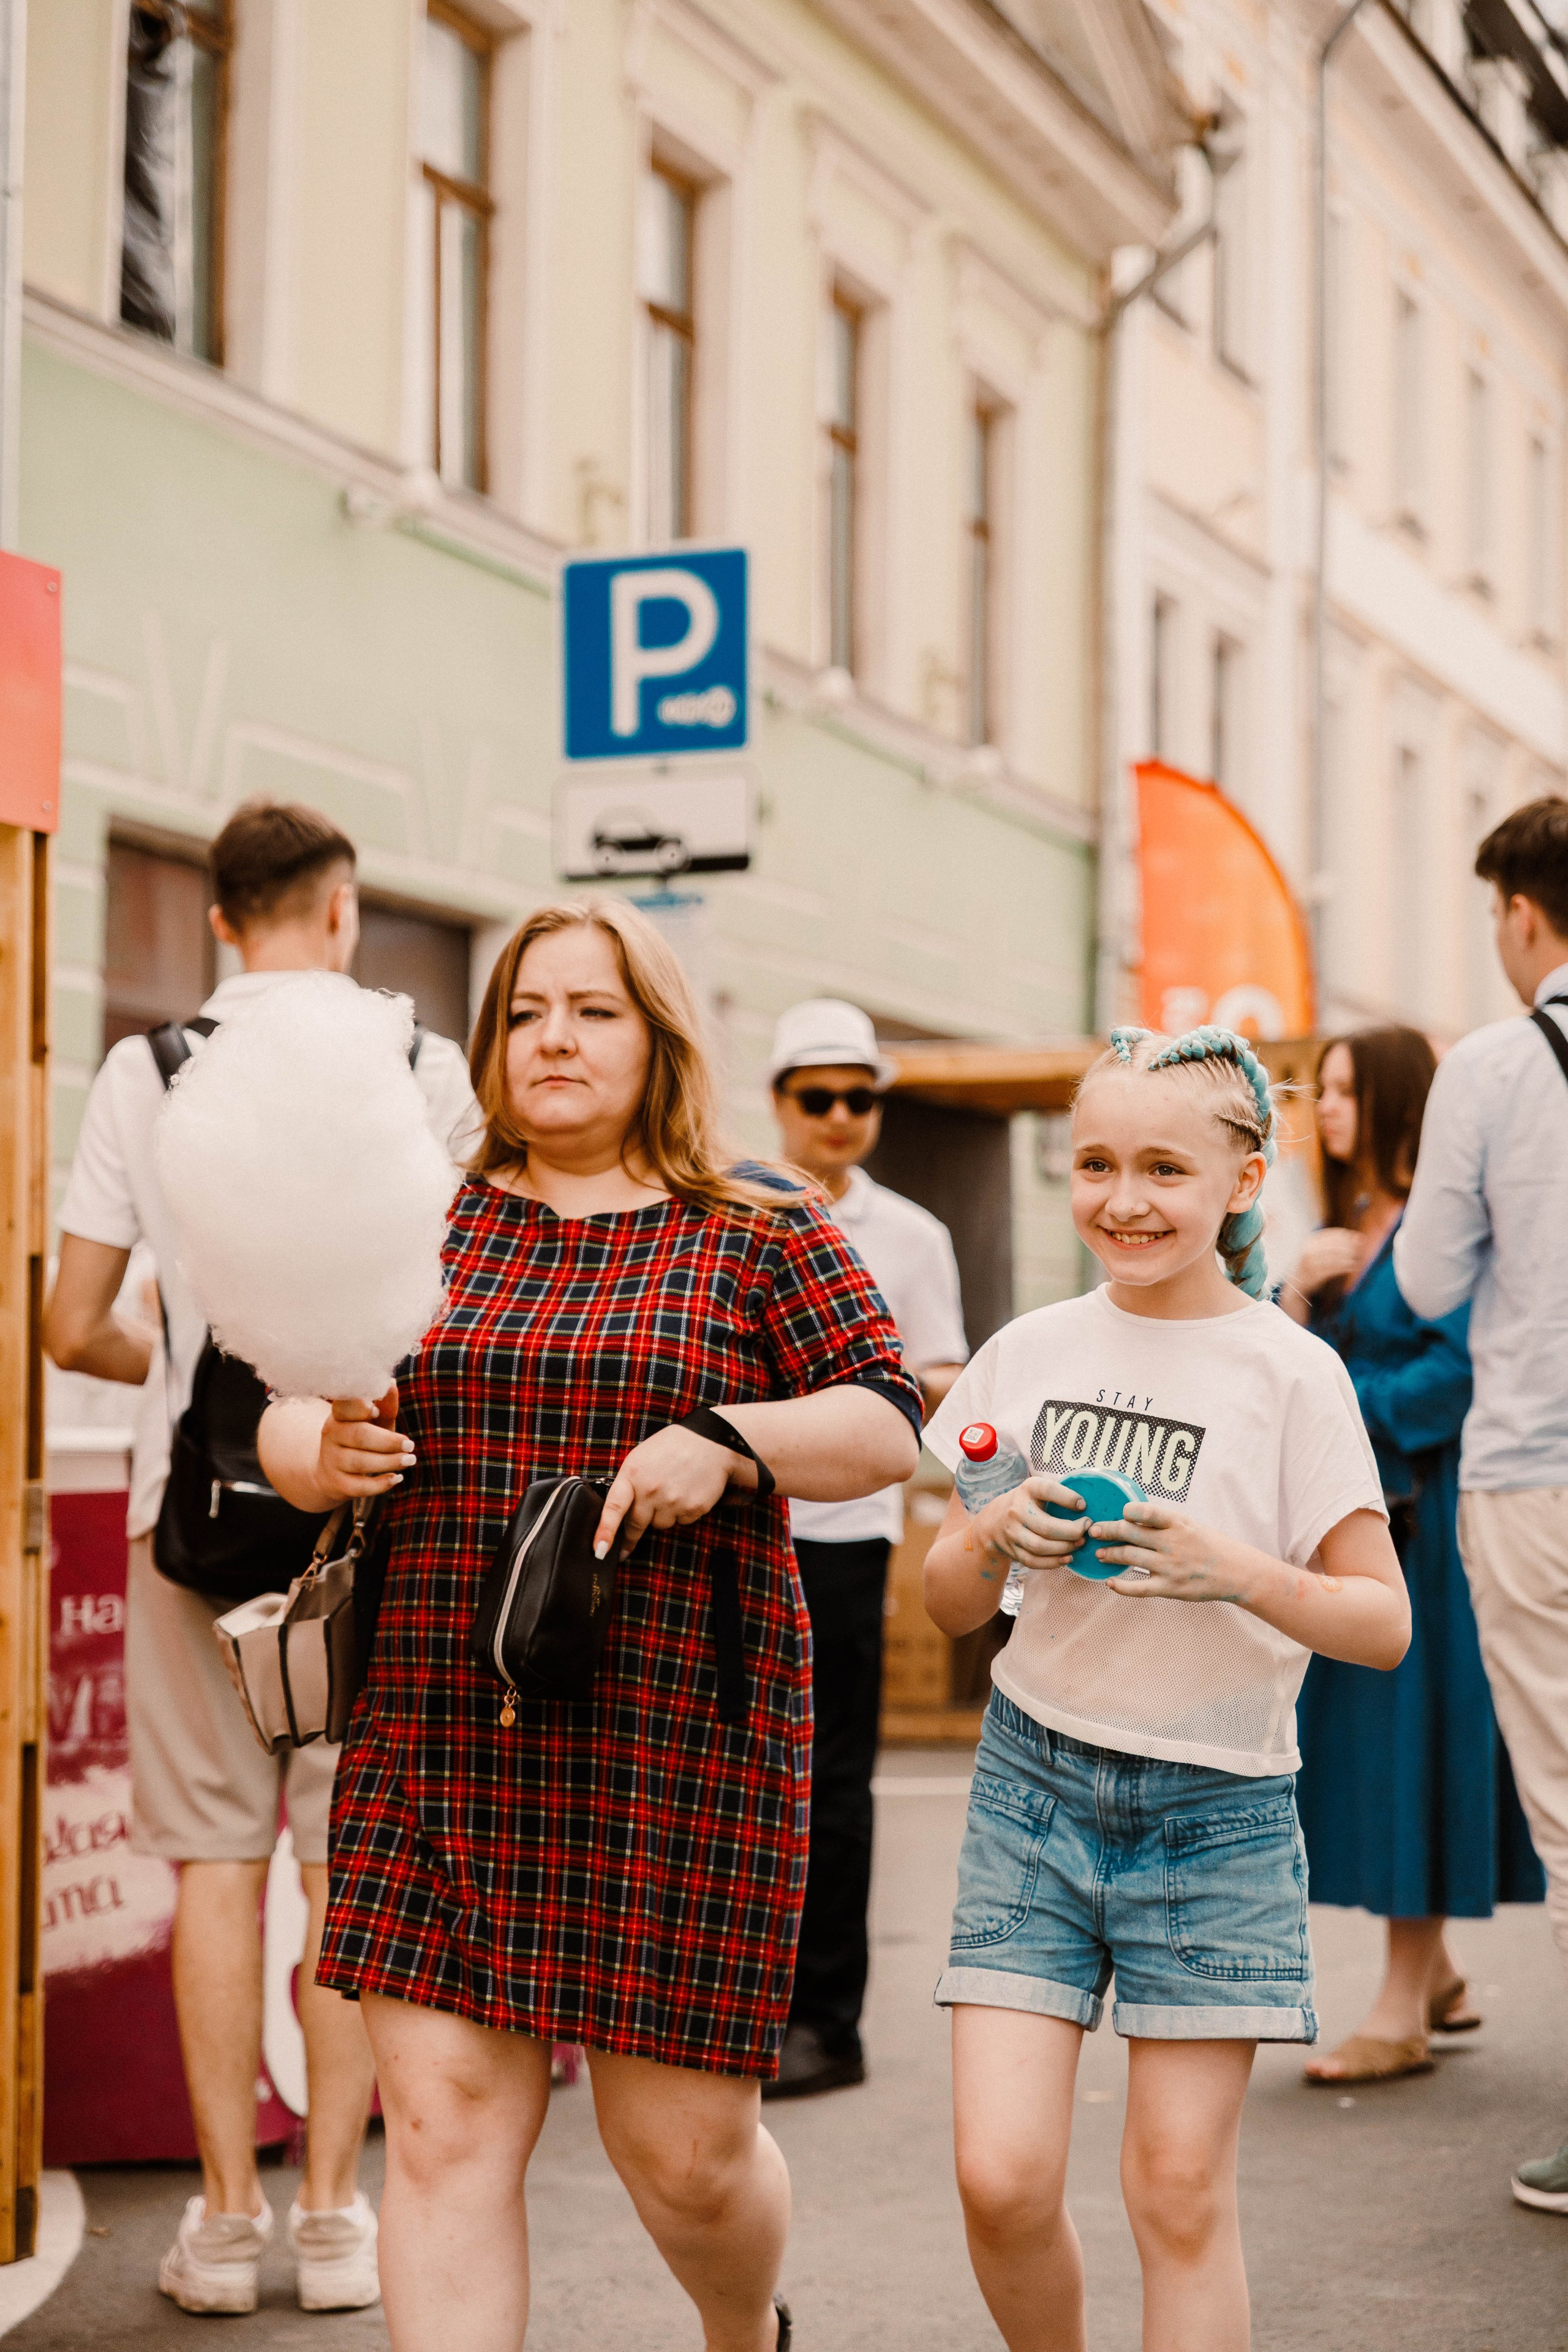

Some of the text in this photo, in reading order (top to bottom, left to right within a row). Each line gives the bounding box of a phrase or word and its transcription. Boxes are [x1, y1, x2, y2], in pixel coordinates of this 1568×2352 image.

[611, 568, 720, 739] P
[1096, 1389, 1154, 1411] STAY
[1041, 1407, 1196, 1491] YOUNG
